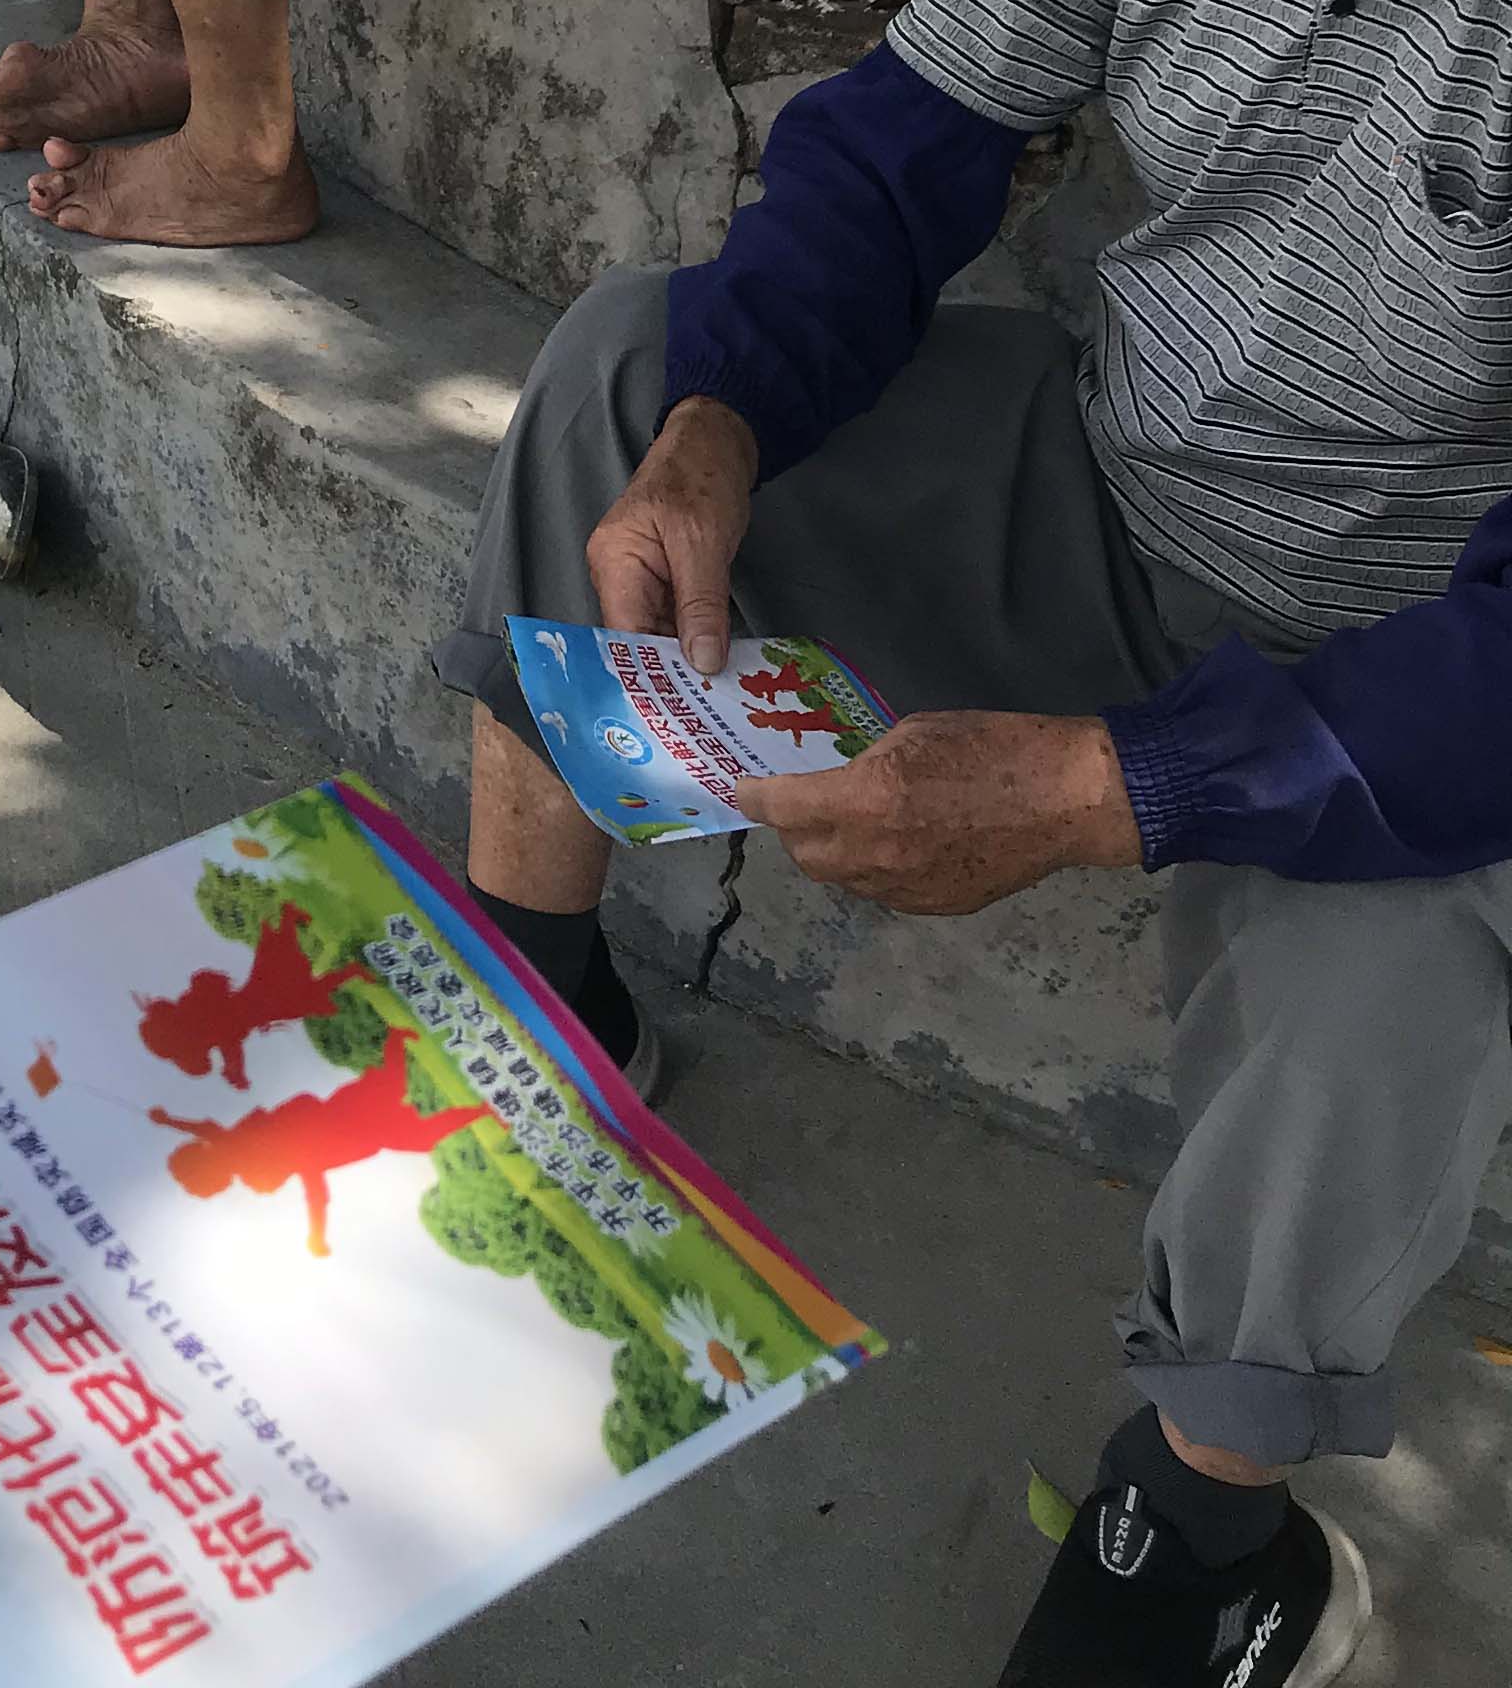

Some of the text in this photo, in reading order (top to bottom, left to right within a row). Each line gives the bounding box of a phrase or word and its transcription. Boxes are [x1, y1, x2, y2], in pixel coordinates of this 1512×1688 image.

[636, 643, 752, 780] 安全发展基础
